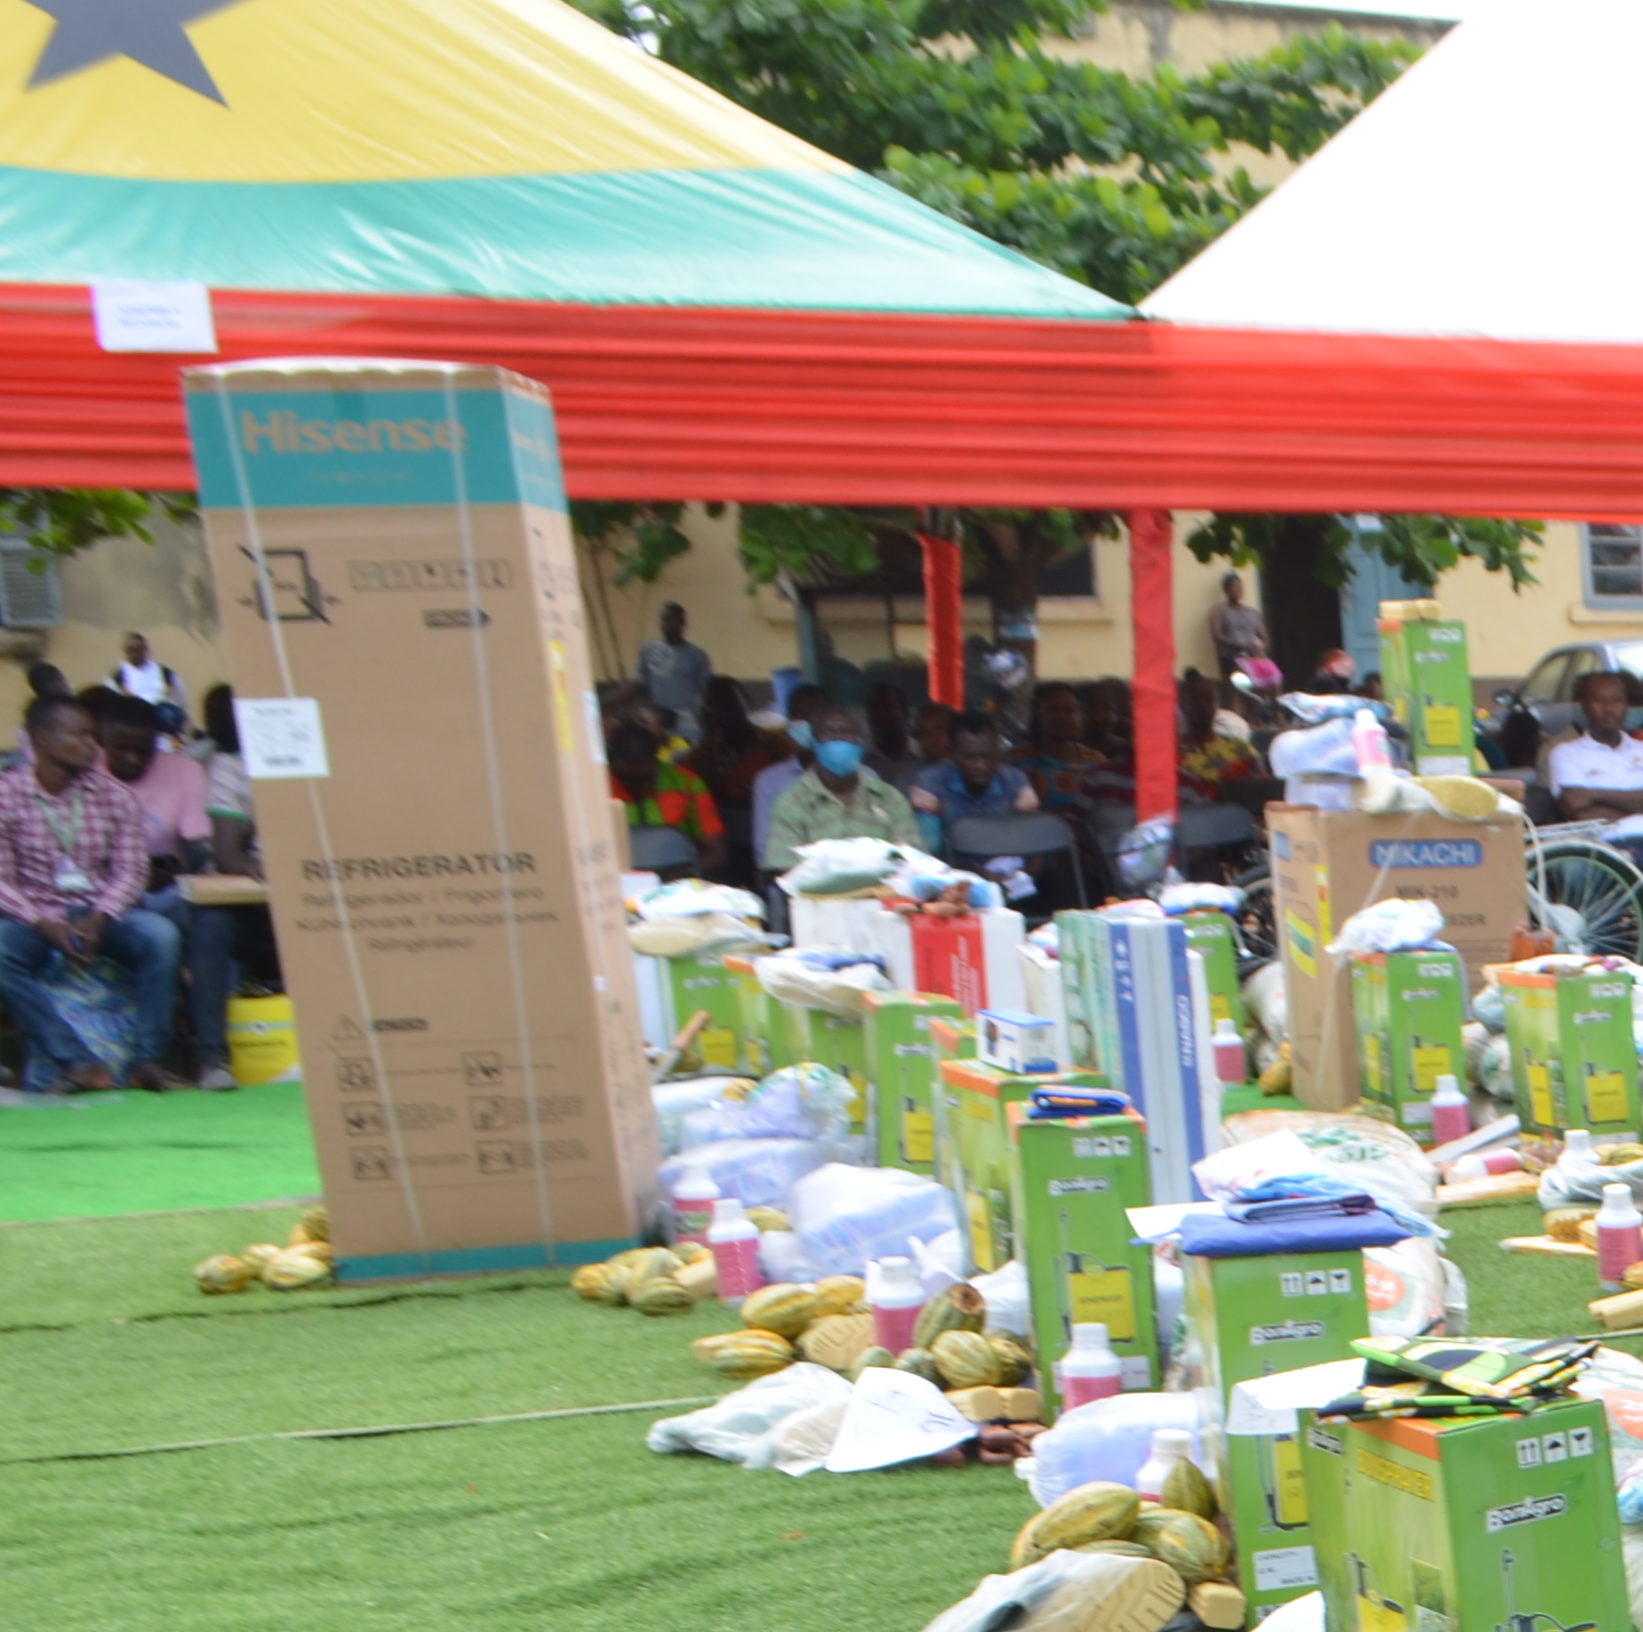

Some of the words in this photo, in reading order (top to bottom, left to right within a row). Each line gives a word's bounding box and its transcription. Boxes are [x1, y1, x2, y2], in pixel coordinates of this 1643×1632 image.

[240, 410, 468, 455] Hisense
[301, 852, 537, 881] REFRIGERATOR
[1486, 1495, 1566, 1533] BonAgro
